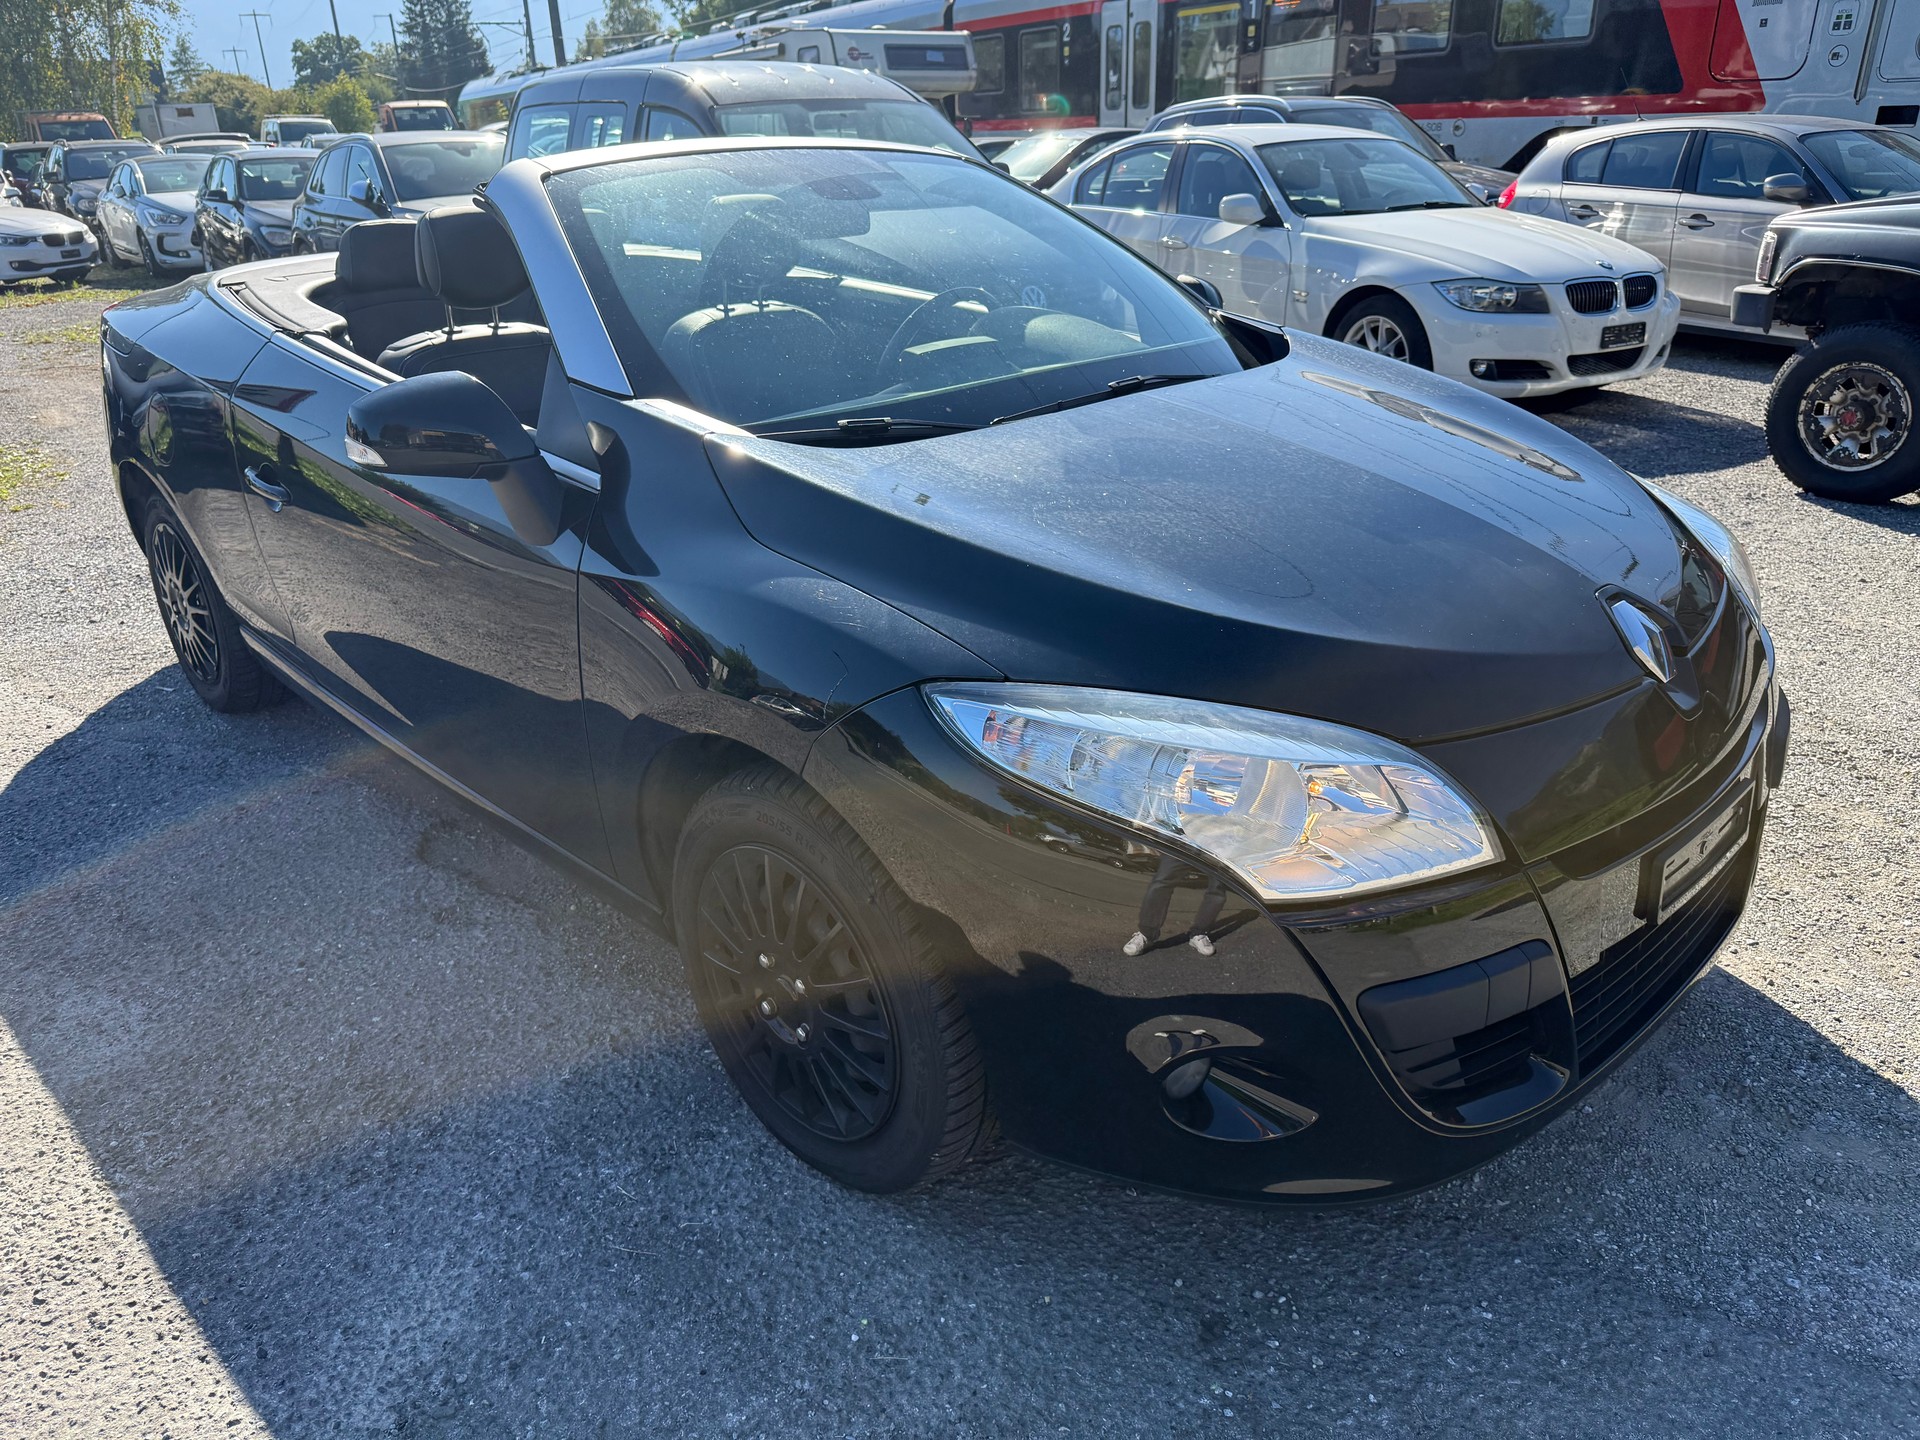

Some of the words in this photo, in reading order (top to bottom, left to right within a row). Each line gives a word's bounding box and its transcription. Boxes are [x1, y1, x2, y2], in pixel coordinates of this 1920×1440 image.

[1062, 22, 1071, 42] 2
[755, 810, 793, 837] 205/55
[795, 832, 816, 856] R16
